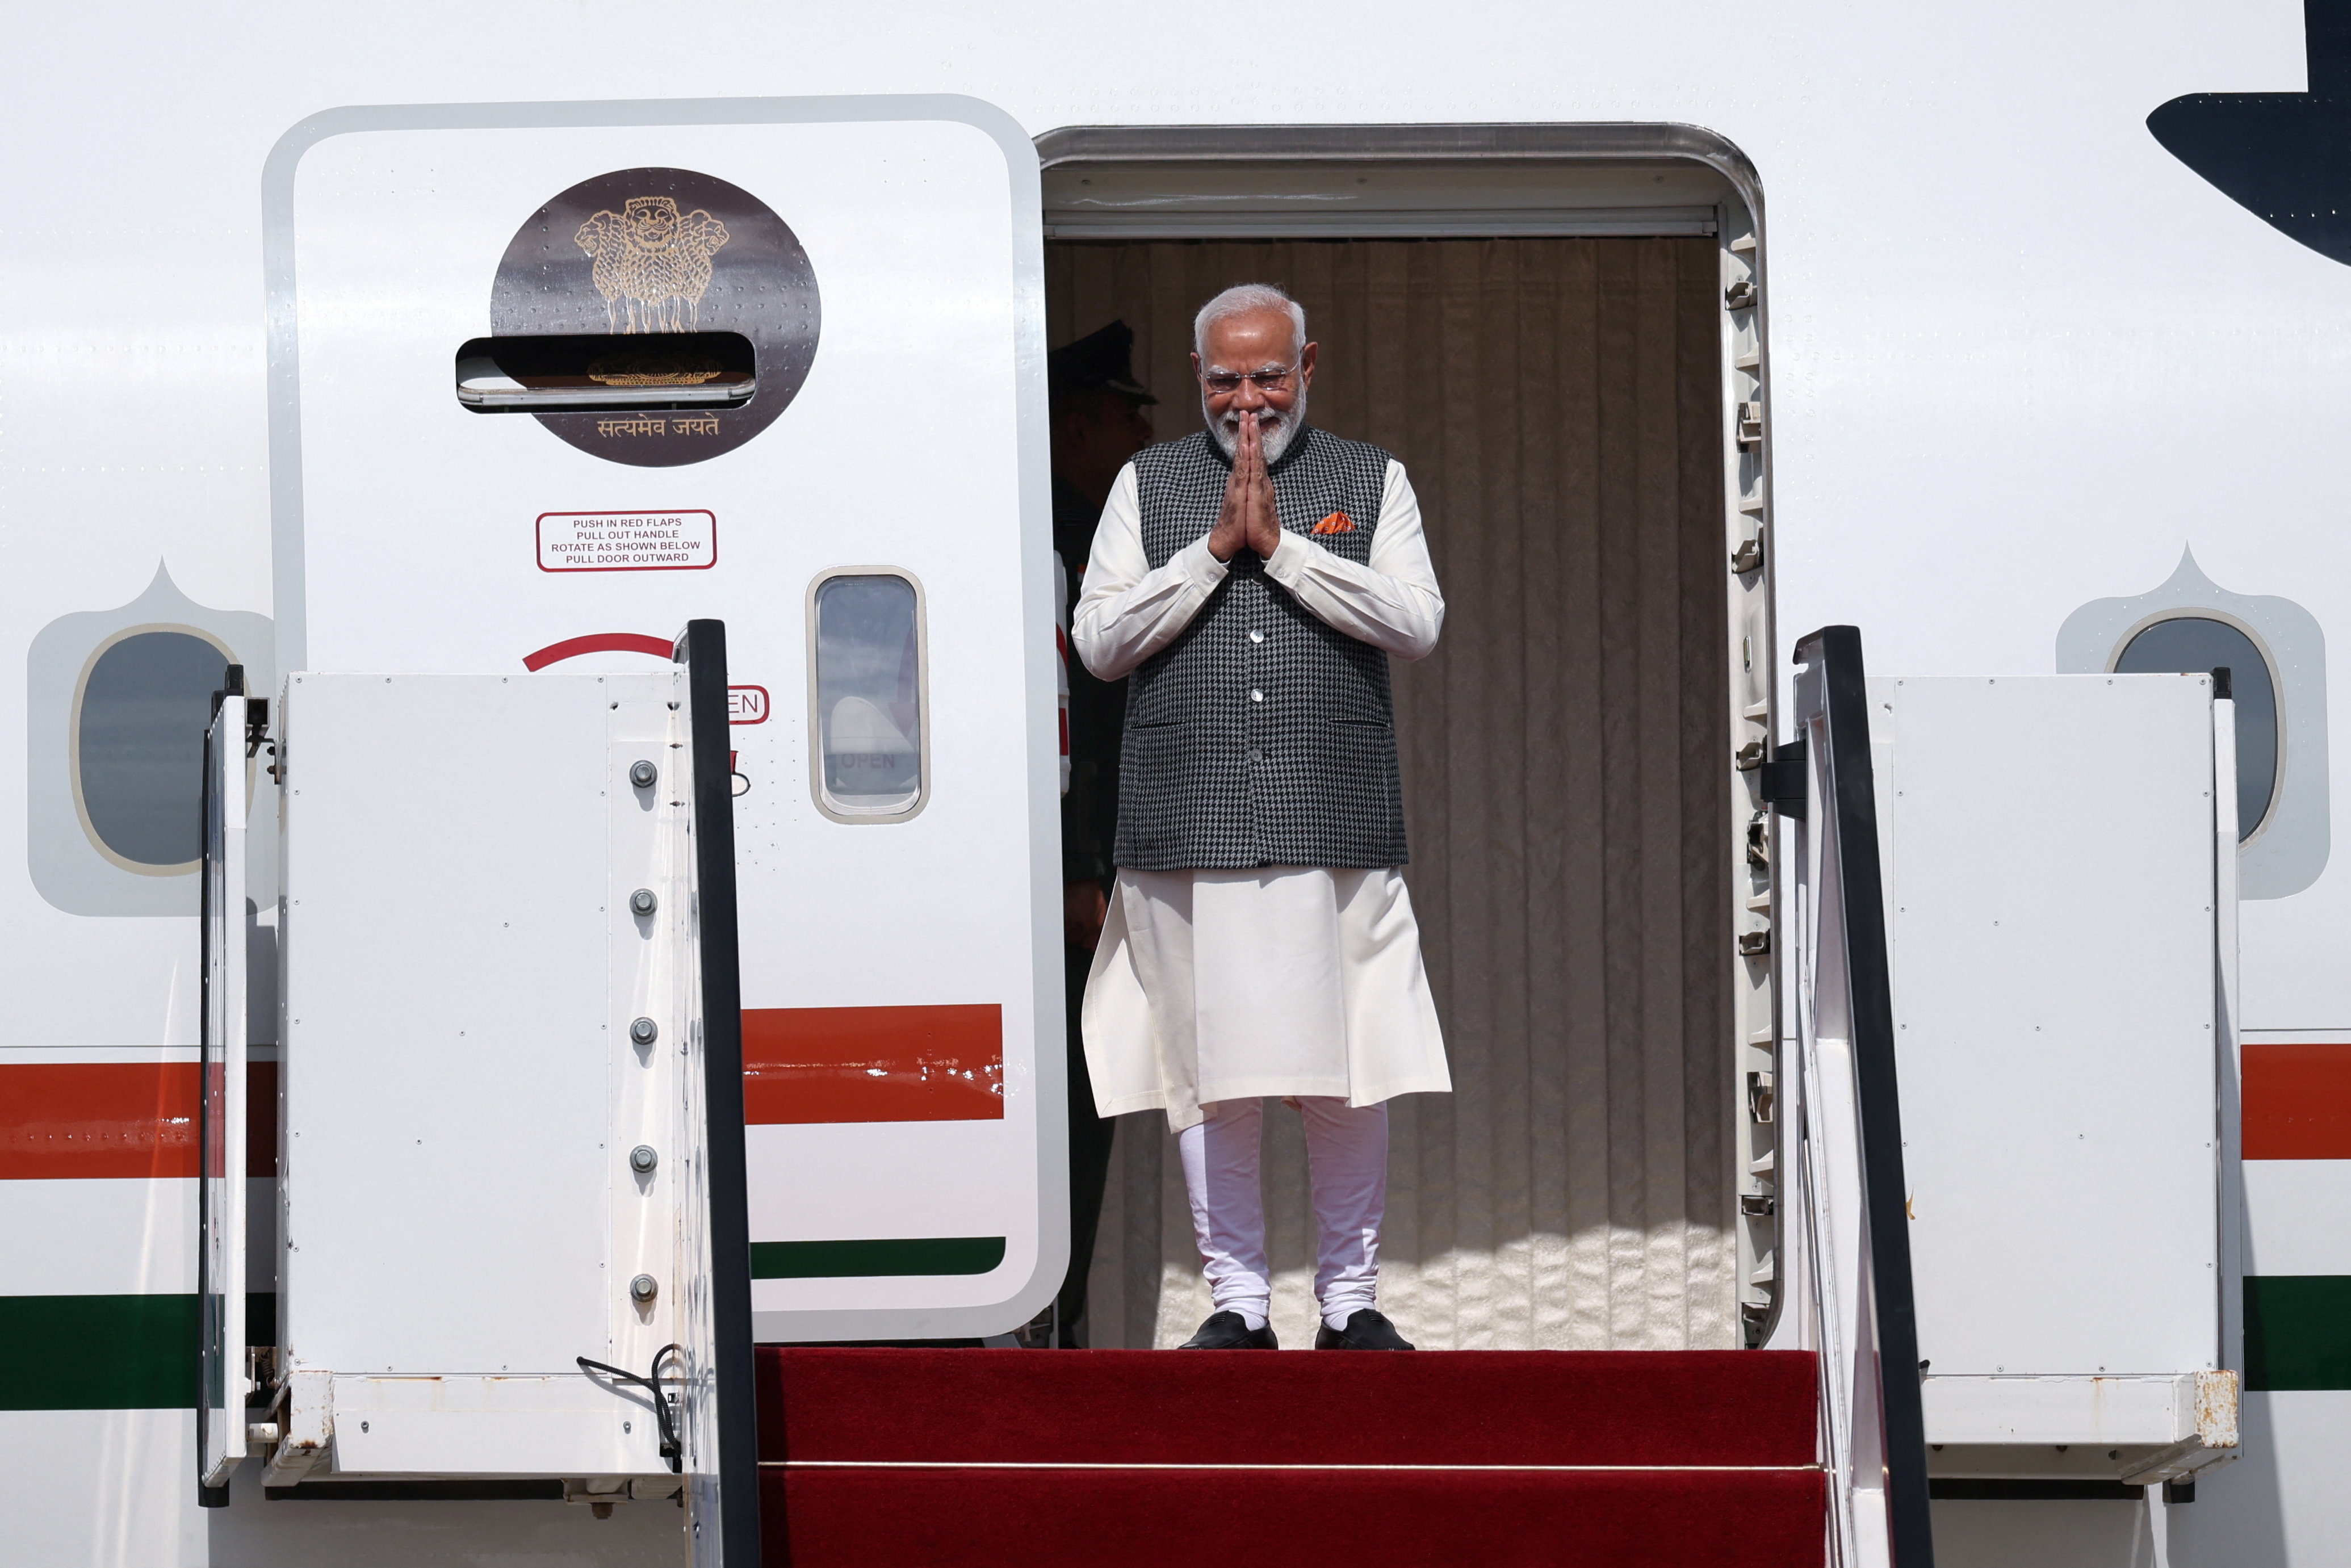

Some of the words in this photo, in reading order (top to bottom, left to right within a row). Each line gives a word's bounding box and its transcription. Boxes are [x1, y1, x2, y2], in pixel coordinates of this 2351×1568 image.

[597, 413, 667, 438] सत्यमेव
[672, 412, 719, 436] जयते
[573, 519, 603, 529] PUSH
[606, 519, 617, 527] IN
[621, 518, 643, 527] RED
[647, 518, 682, 527] FLAPS
[577, 531, 605, 540] PULL
[607, 531, 631, 539] OUT
[634, 530, 679, 539] HANDLE
[551, 543, 594, 552] ROTATE
[597, 543, 612, 551] AS
[615, 542, 656, 551] SHOWN
[660, 541, 701, 550] BELOW
[566, 555, 594, 564] PULL
[597, 554, 630, 563] DOOR
[632, 553, 689, 563] OUTWARD
[728, 694, 757, 713] EN
[841, 753, 895, 769] OPEN
